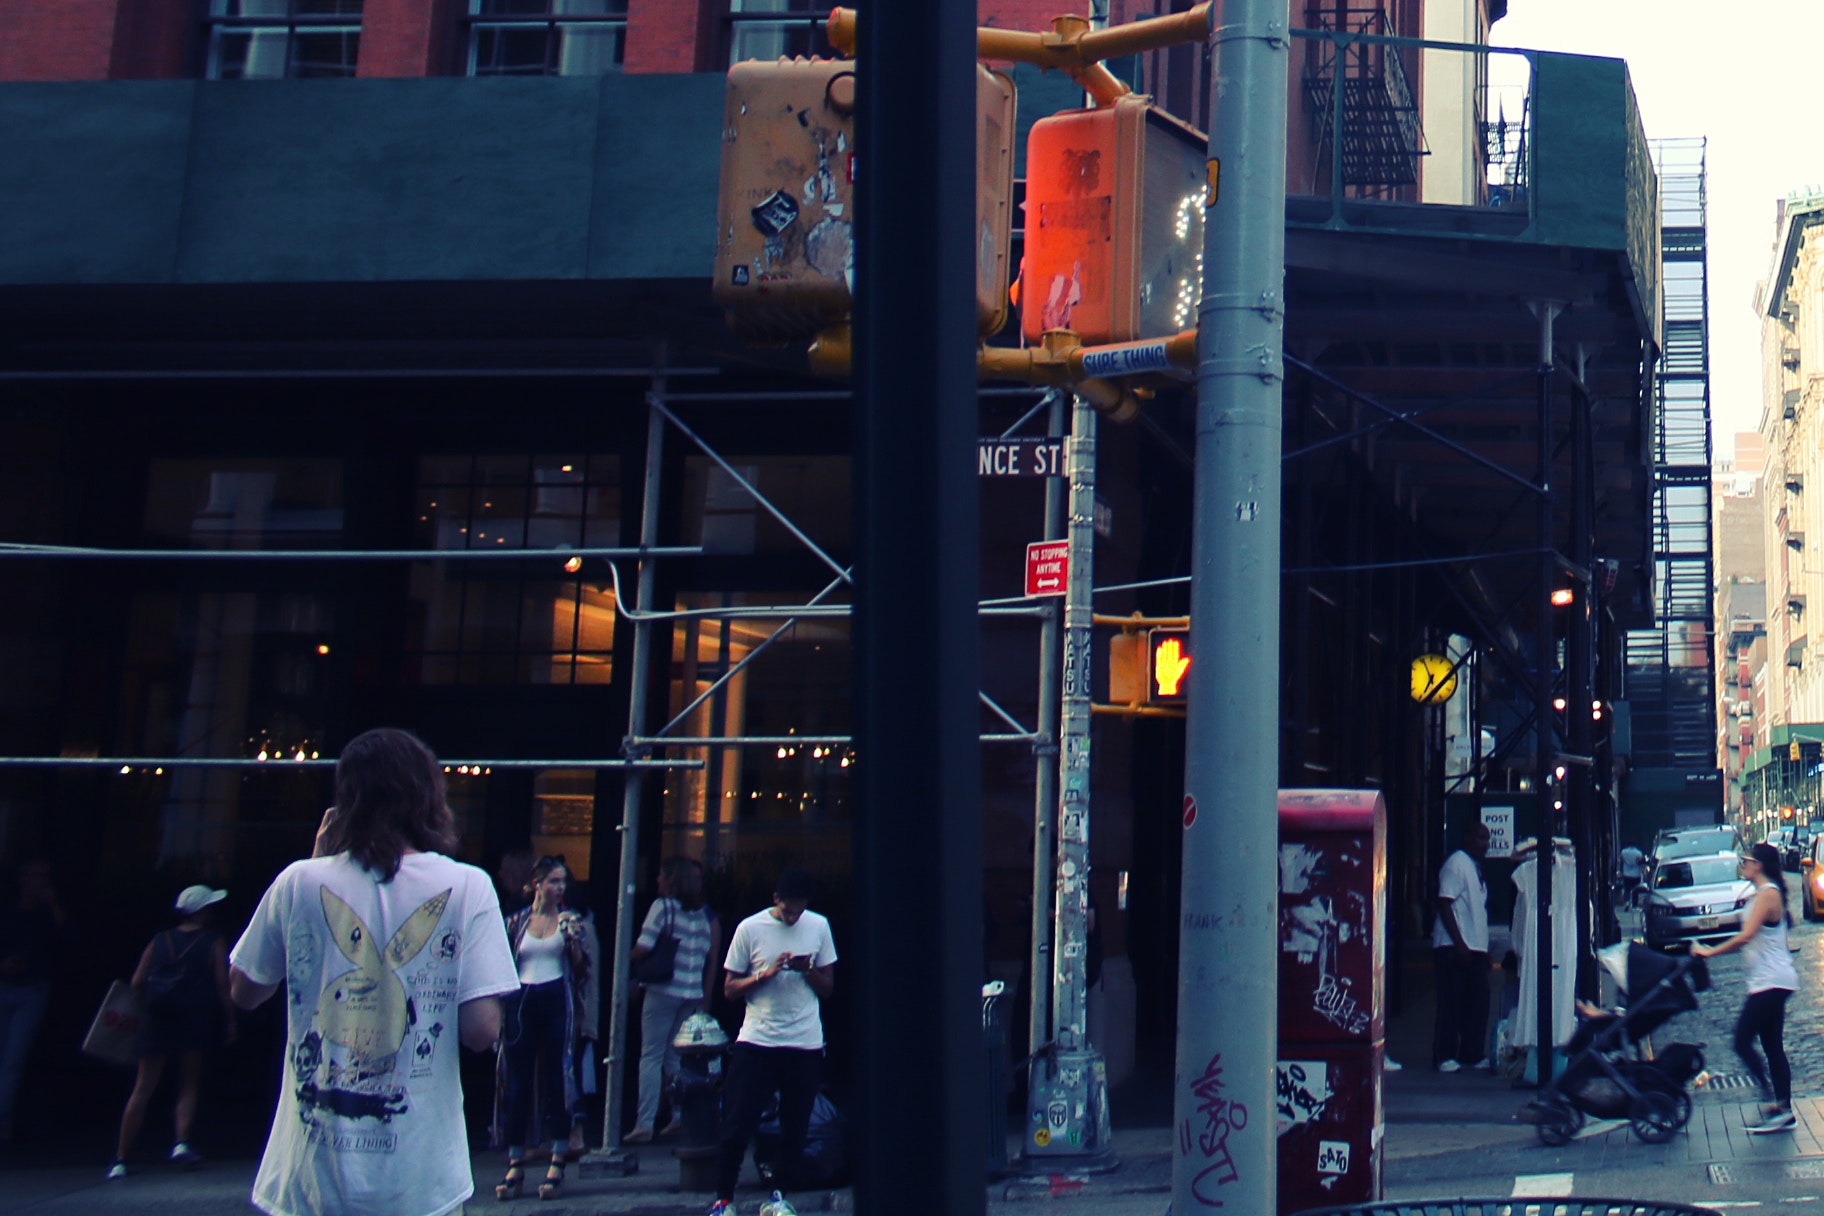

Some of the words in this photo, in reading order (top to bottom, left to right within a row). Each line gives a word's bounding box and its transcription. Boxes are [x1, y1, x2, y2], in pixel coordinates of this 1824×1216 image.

[1084, 351, 1122, 376] SURE
[1122, 345, 1167, 371] THING
[978, 444, 1020, 476] NCE
[1033, 444, 1060, 476] ST
[1030, 549, 1040, 561] NO
[1040, 546, 1069, 561] STOPPING
[1036, 561, 1063, 575] ANYTIME
[1485, 814, 1510, 823] POST
[1490, 827, 1505, 836] NO
[1319, 1146, 1347, 1172] SATO
